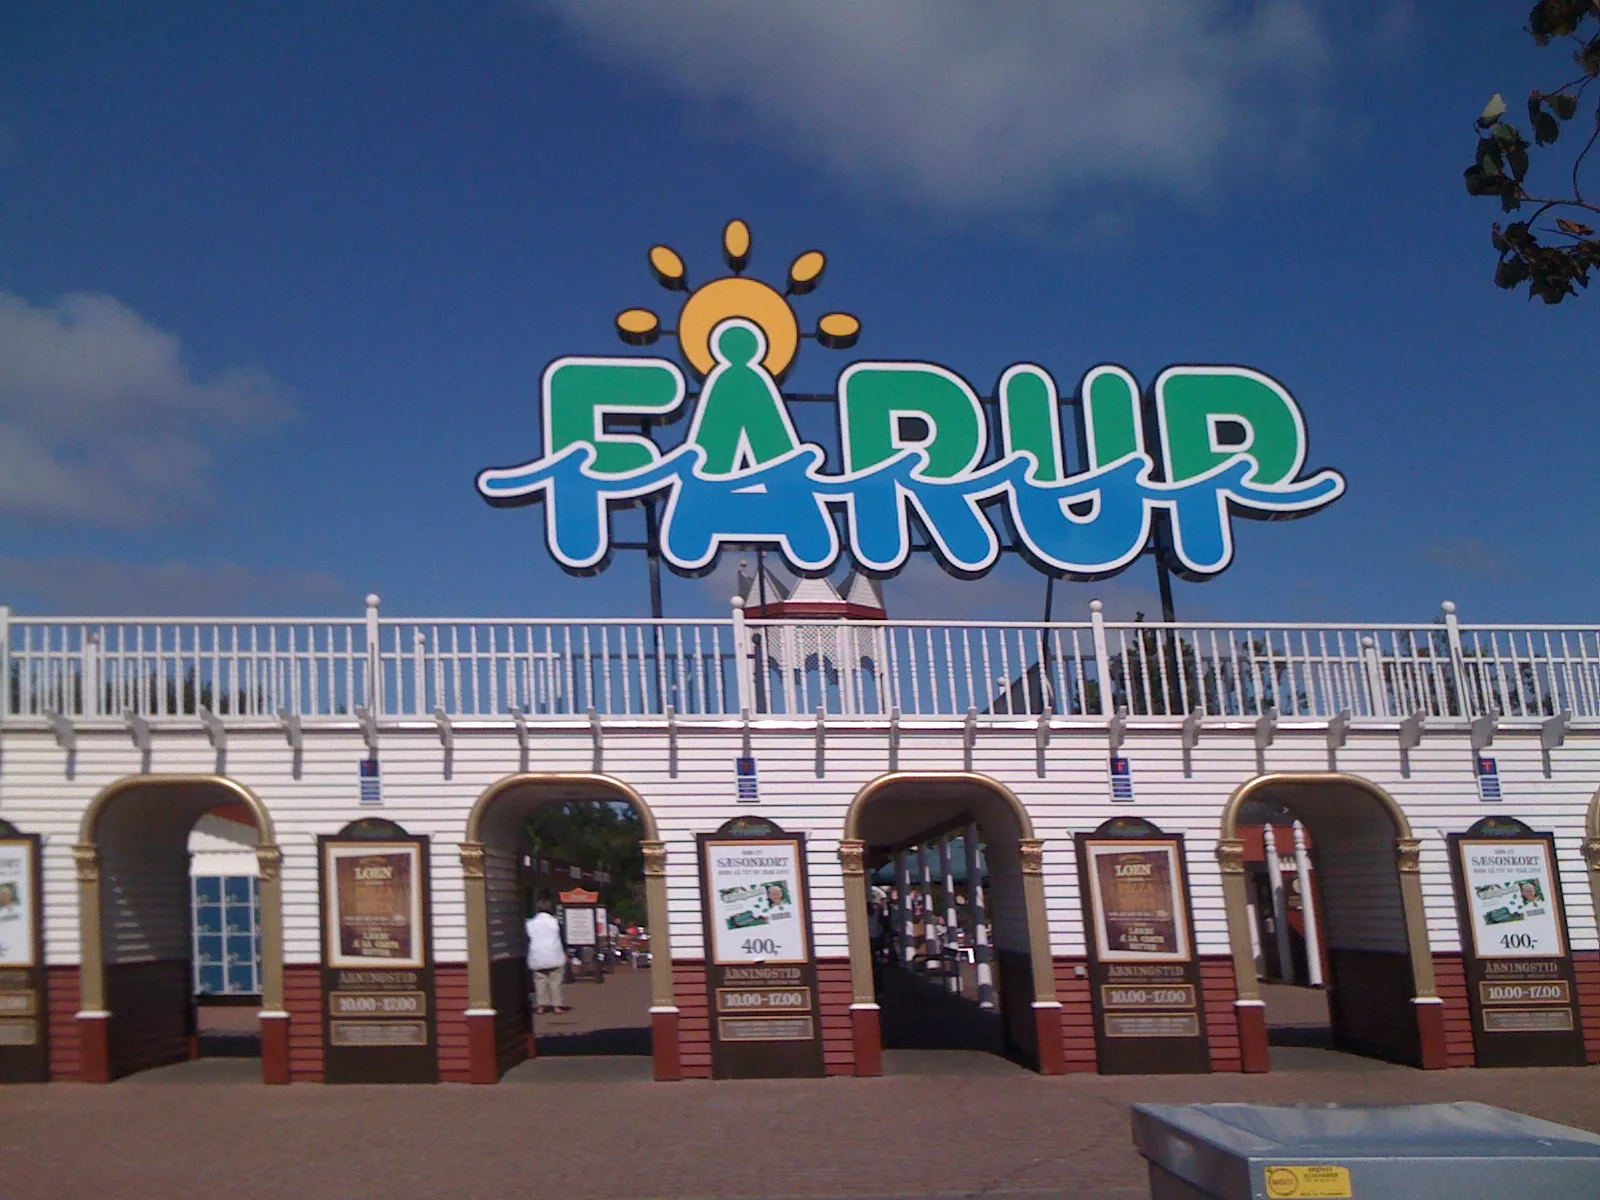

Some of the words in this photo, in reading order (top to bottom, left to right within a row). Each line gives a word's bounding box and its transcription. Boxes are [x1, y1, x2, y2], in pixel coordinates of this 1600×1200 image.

[477, 317, 1345, 575] FÅRUP
[717, 857, 789, 868] SÆSONKORT
[1471, 856, 1540, 866] SÆSONKORT
[741, 938, 782, 956] 400,-
[1500, 933, 1538, 950] 400,-
[1488, 986, 1561, 1000] 10.00-17.00
